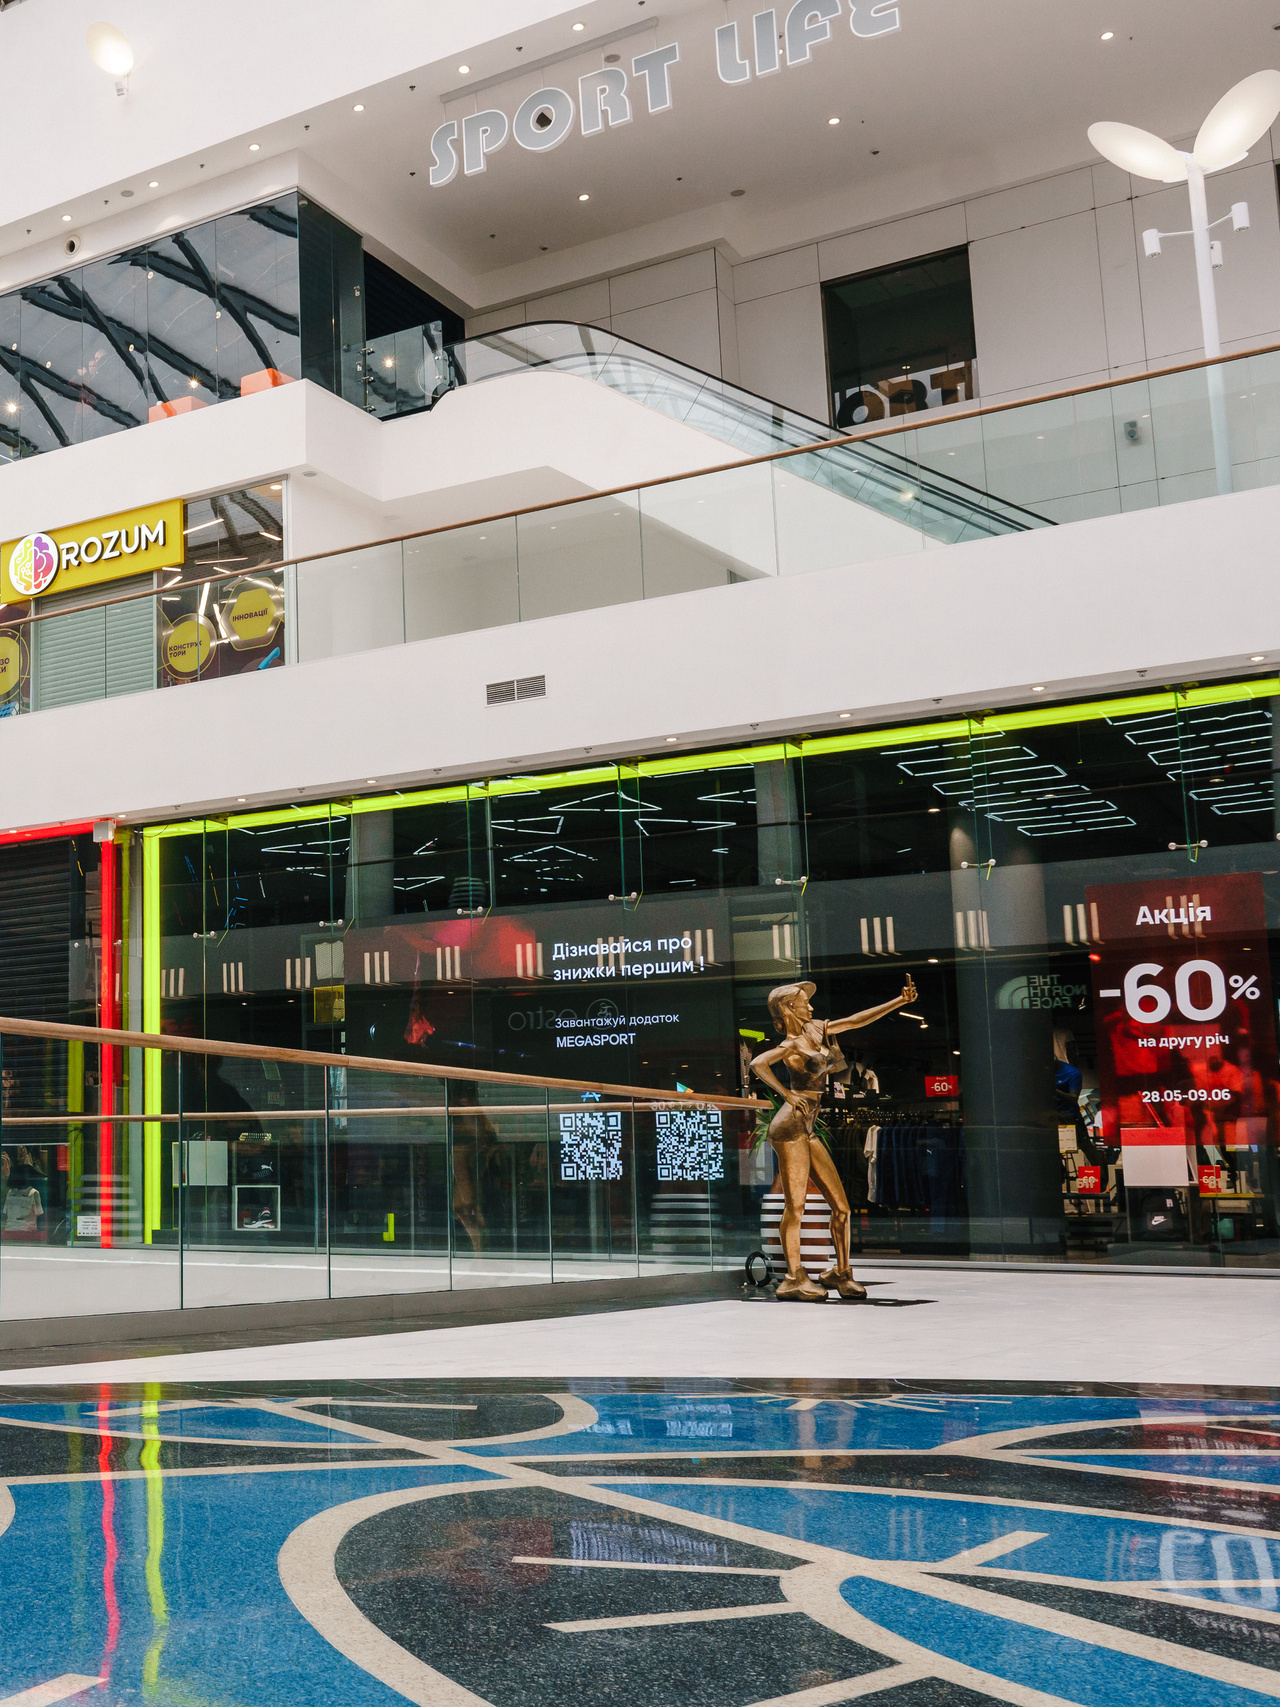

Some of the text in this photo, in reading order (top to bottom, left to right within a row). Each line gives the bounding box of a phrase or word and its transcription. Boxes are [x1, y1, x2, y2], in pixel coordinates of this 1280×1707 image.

[429, 0, 901, 187] SPORT LIFE
[59, 519, 166, 570] ROZUM
[232, 608, 269, 622] ІННОВАЦІЇ
[169, 651, 187, 659] ТОРИ
[1136, 902, 1212, 926] Акція
[552, 937, 692, 961] Дізнавайся про
[553, 965, 616, 981] знижки
[622, 961, 694, 979] першим
[554, 1012, 680, 1029] Завантажуй додаток
[556, 1033, 636, 1048] MEGASPORT
[1138, 1033, 1230, 1049] на другу річ
[1141, 1088, 1231, 1103] 28.05-09.06
